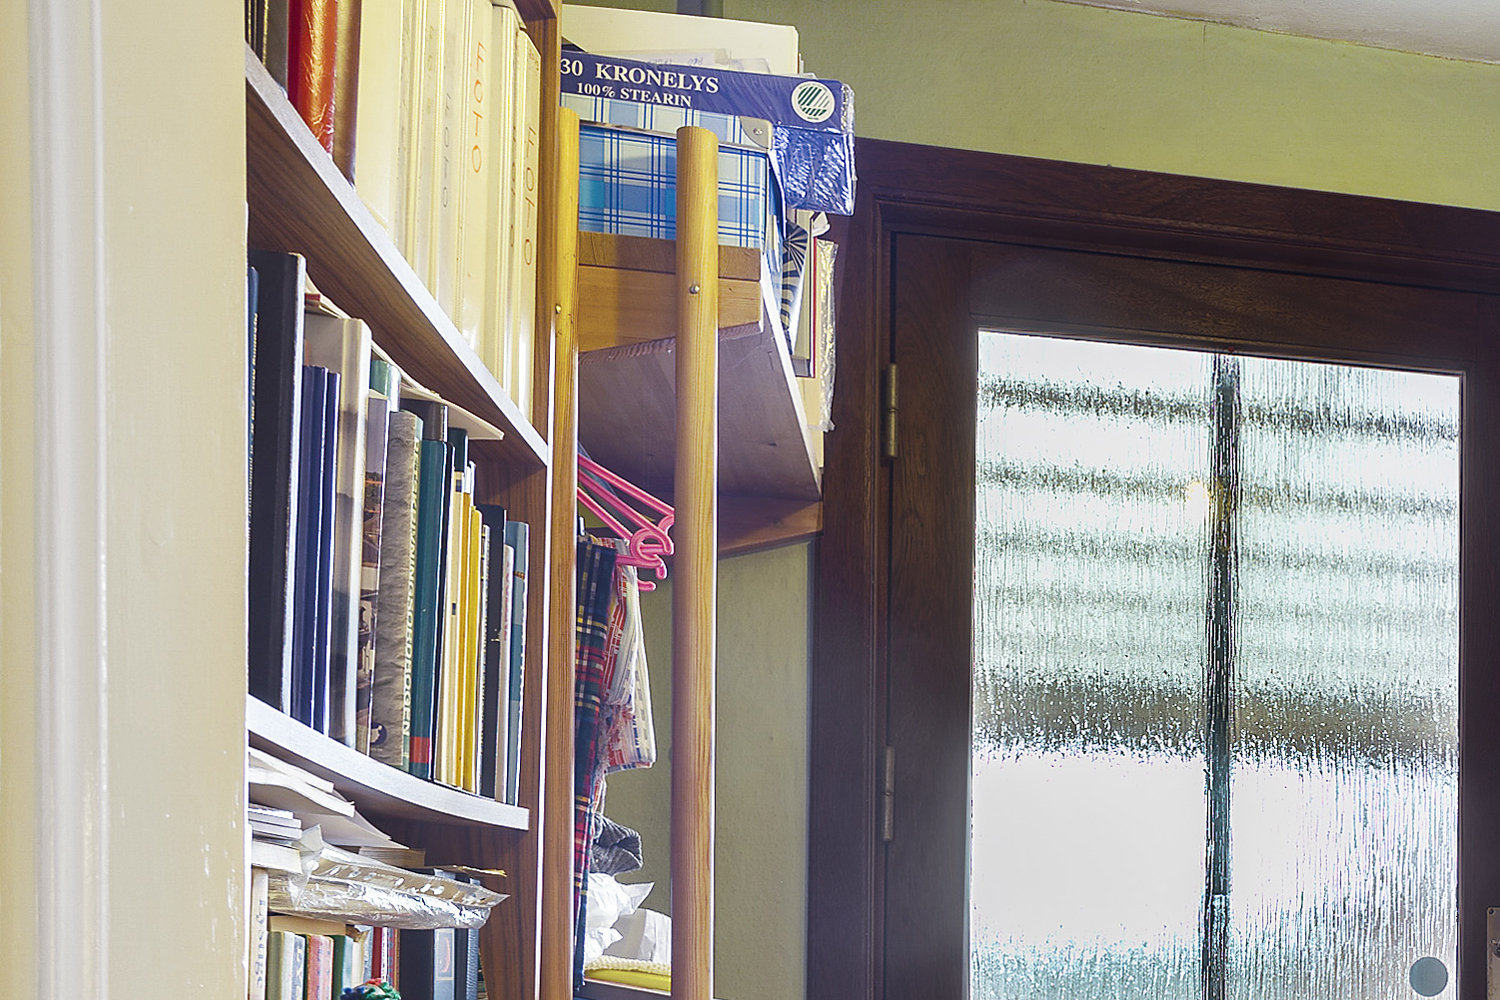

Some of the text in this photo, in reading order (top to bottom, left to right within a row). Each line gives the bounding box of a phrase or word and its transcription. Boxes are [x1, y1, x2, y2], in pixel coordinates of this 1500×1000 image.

[471, 41, 488, 174] FOTO
[560, 58, 584, 77] 30
[594, 62, 720, 94] KRONELYS
[576, 81, 692, 108] 100% STEARIN
[523, 125, 536, 267] FOTO
